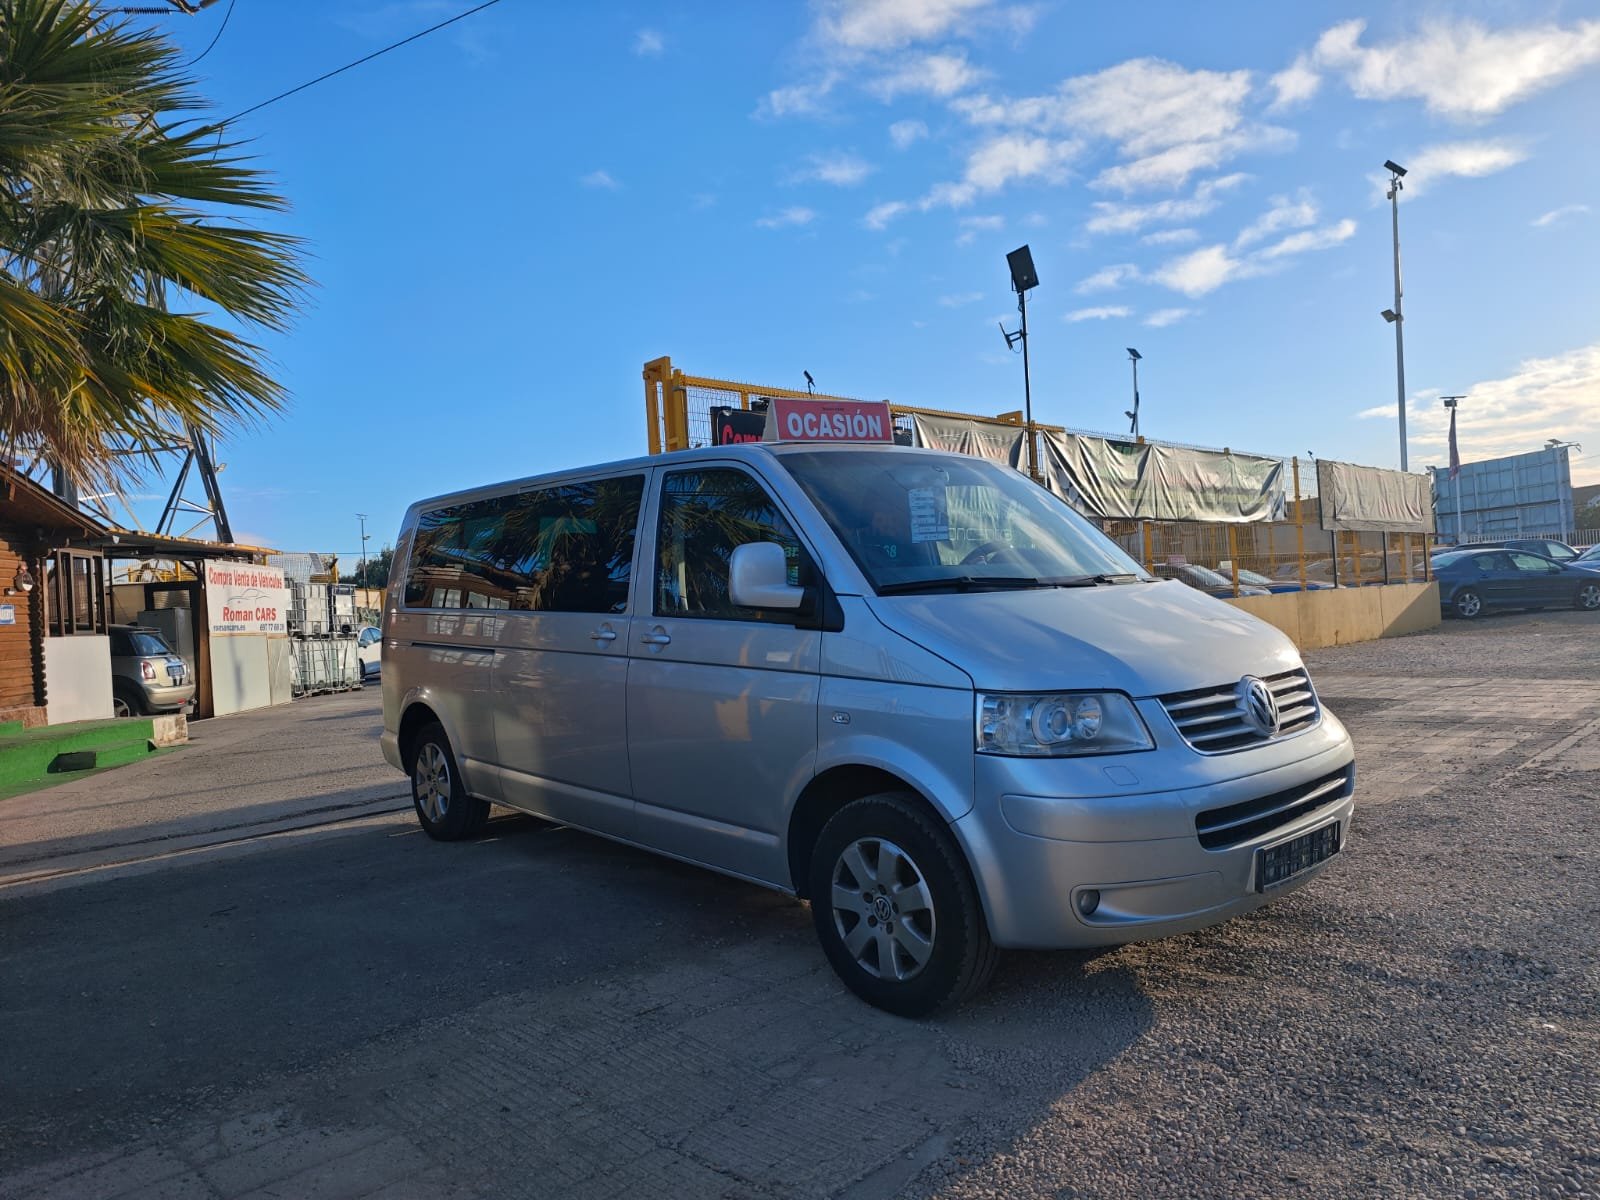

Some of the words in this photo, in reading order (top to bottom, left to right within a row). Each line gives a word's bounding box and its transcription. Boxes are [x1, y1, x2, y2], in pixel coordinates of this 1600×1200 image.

[787, 409, 883, 438] OCASIÓN
[208, 567, 232, 588] Compra
[234, 570, 250, 586] Venta
[251, 573, 258, 587] de
[223, 607, 253, 621] Roman
[255, 607, 277, 621] CARS
